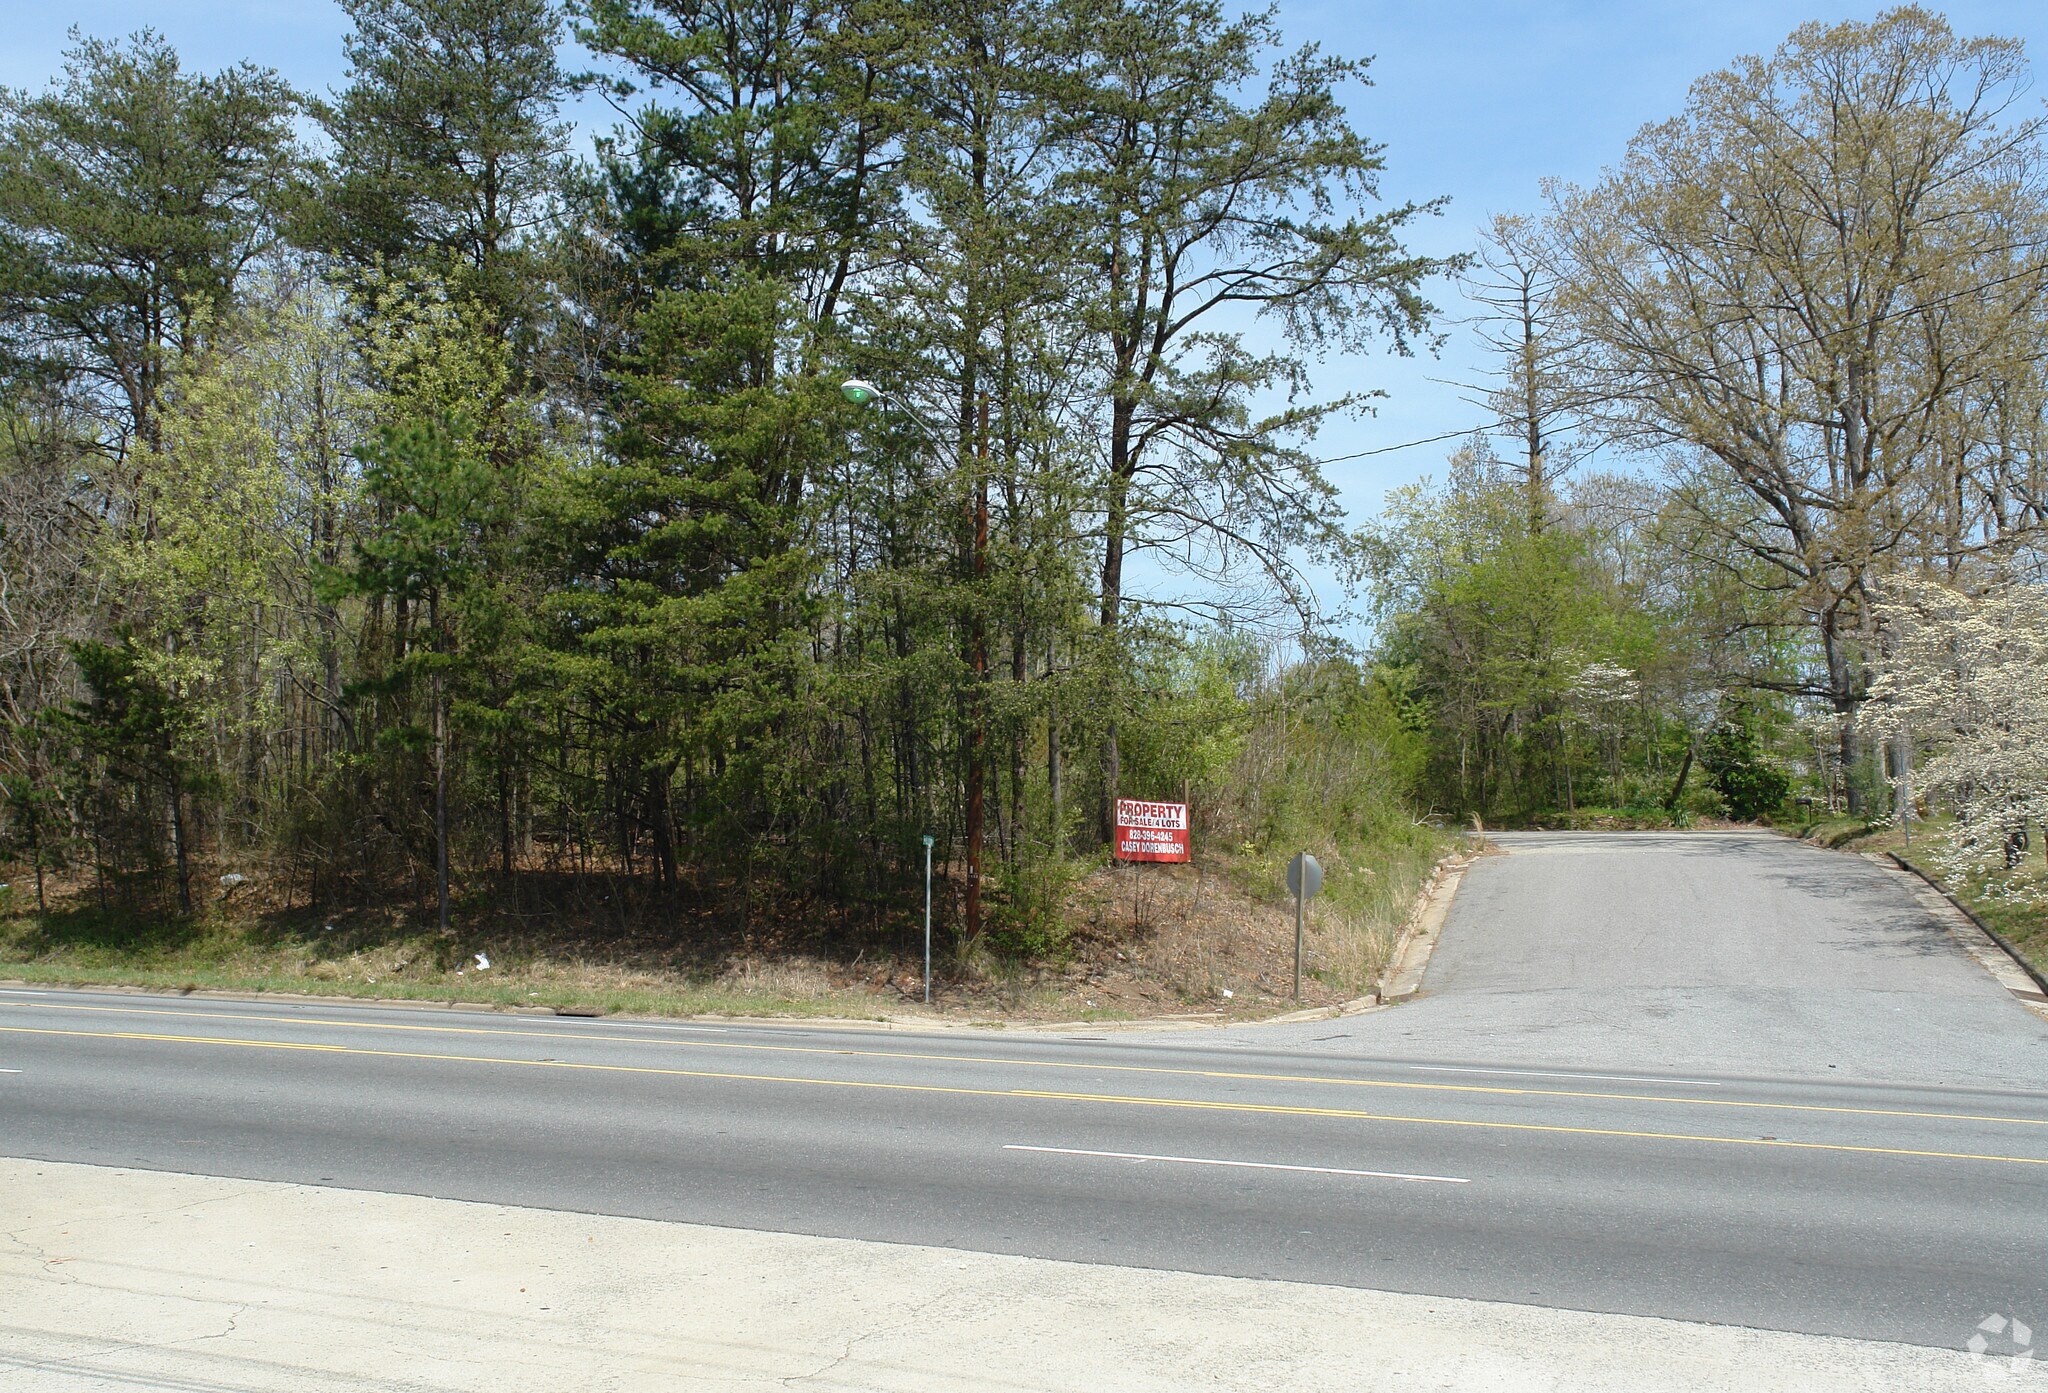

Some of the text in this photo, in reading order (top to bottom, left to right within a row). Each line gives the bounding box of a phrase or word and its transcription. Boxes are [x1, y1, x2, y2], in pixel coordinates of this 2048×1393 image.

[1120, 801, 1182, 818] PROPERTY
[1120, 816, 1134, 825] FOR
[1161, 819, 1180, 828] LOTS
[1121, 840, 1140, 852] CASEY
